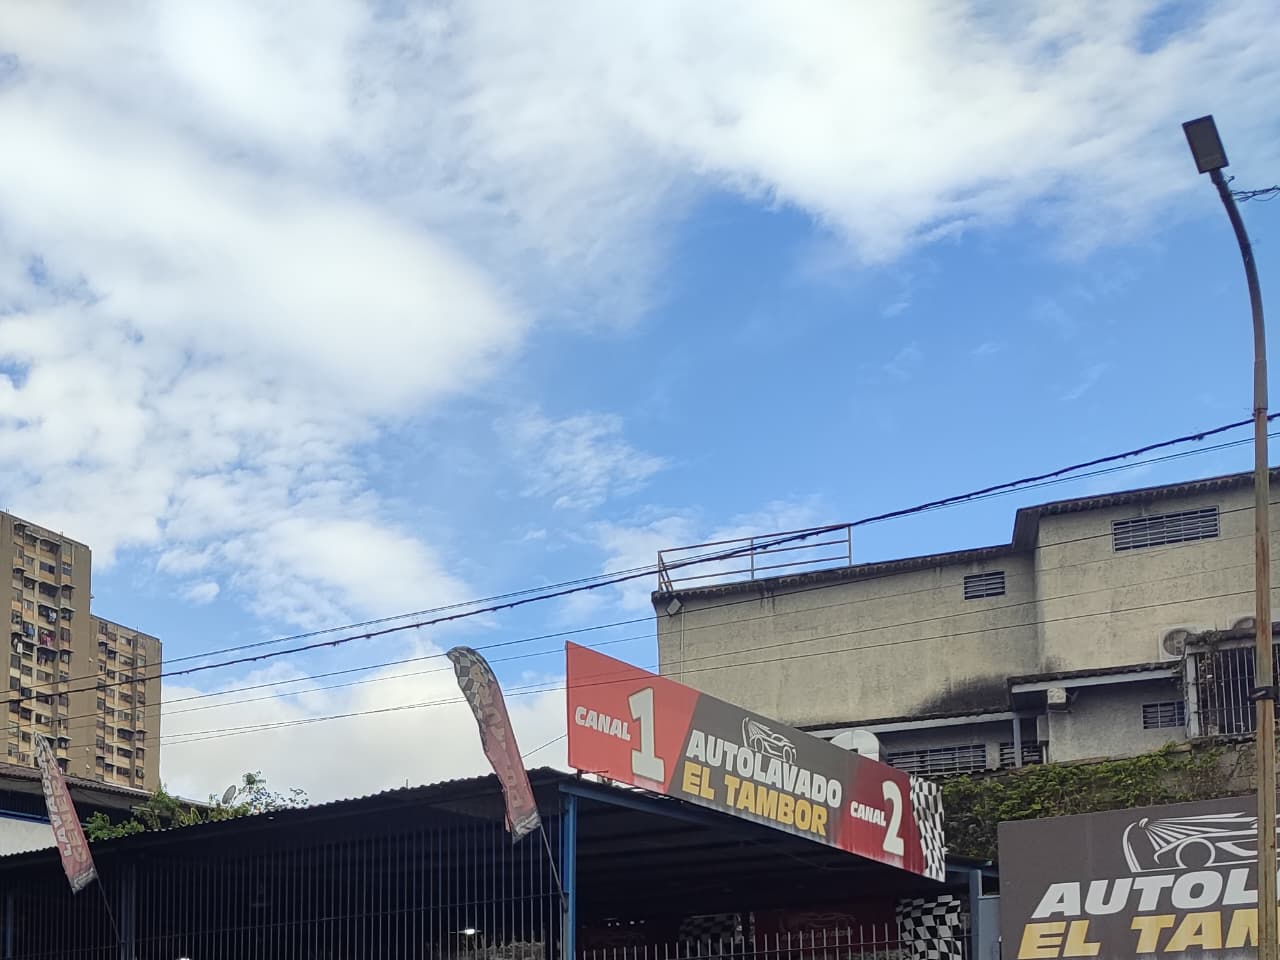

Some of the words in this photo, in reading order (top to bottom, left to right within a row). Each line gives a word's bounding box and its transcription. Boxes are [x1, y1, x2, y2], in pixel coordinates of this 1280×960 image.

[575, 706, 631, 741] CANAL
[628, 687, 665, 783] 1
[685, 729, 843, 809] AUTOLAVADO
[681, 761, 715, 801] EL
[724, 775, 827, 836] TAMBOR
[850, 801, 886, 827] CANAL
[882, 780, 905, 856] 2
[1031, 867, 1258, 918] AUTOL
[1017, 919, 1101, 960] EL
